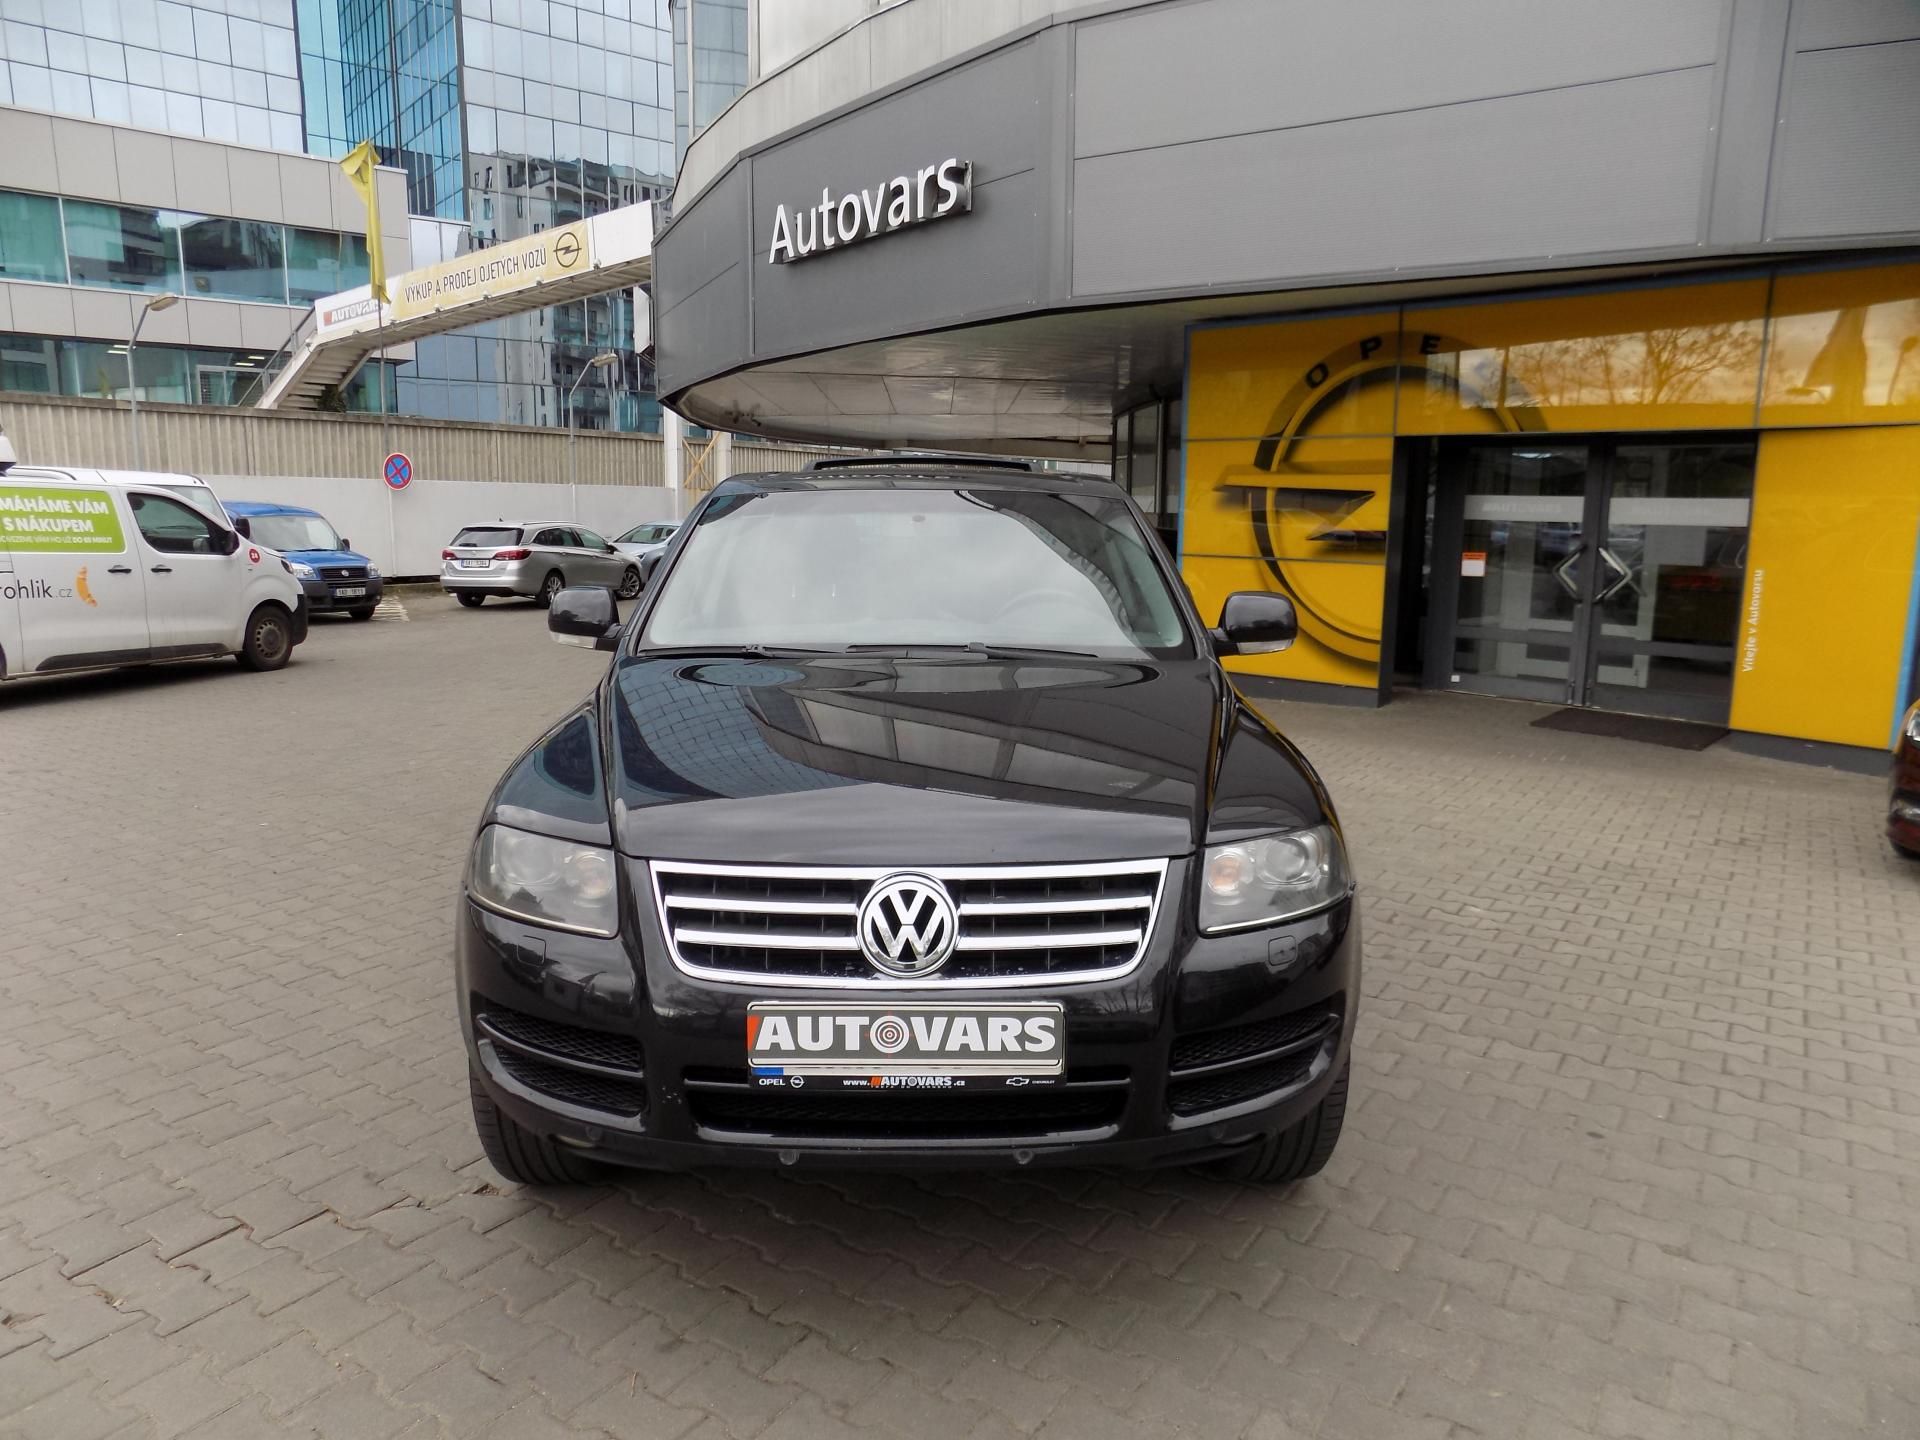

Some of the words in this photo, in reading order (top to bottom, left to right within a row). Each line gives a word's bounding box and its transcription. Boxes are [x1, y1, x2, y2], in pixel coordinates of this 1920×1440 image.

[769, 158, 958, 264] Autovars
[405, 281, 433, 303] VÝKUP
[436, 279, 442, 295] A
[444, 268, 477, 292] PRODEJ
[480, 254, 519, 282] OJETÝCH
[522, 243, 546, 270] VOZŮ
[3, 517, 14, 531] S
[15, 515, 94, 532] NÁKUPEM
[72, 498, 109, 514] VÁM
[1747, 569, 1763, 625] Autovarsu
[755, 1015, 1056, 1053] AUTOVARS
[759, 1078, 786, 1086] OPEL
